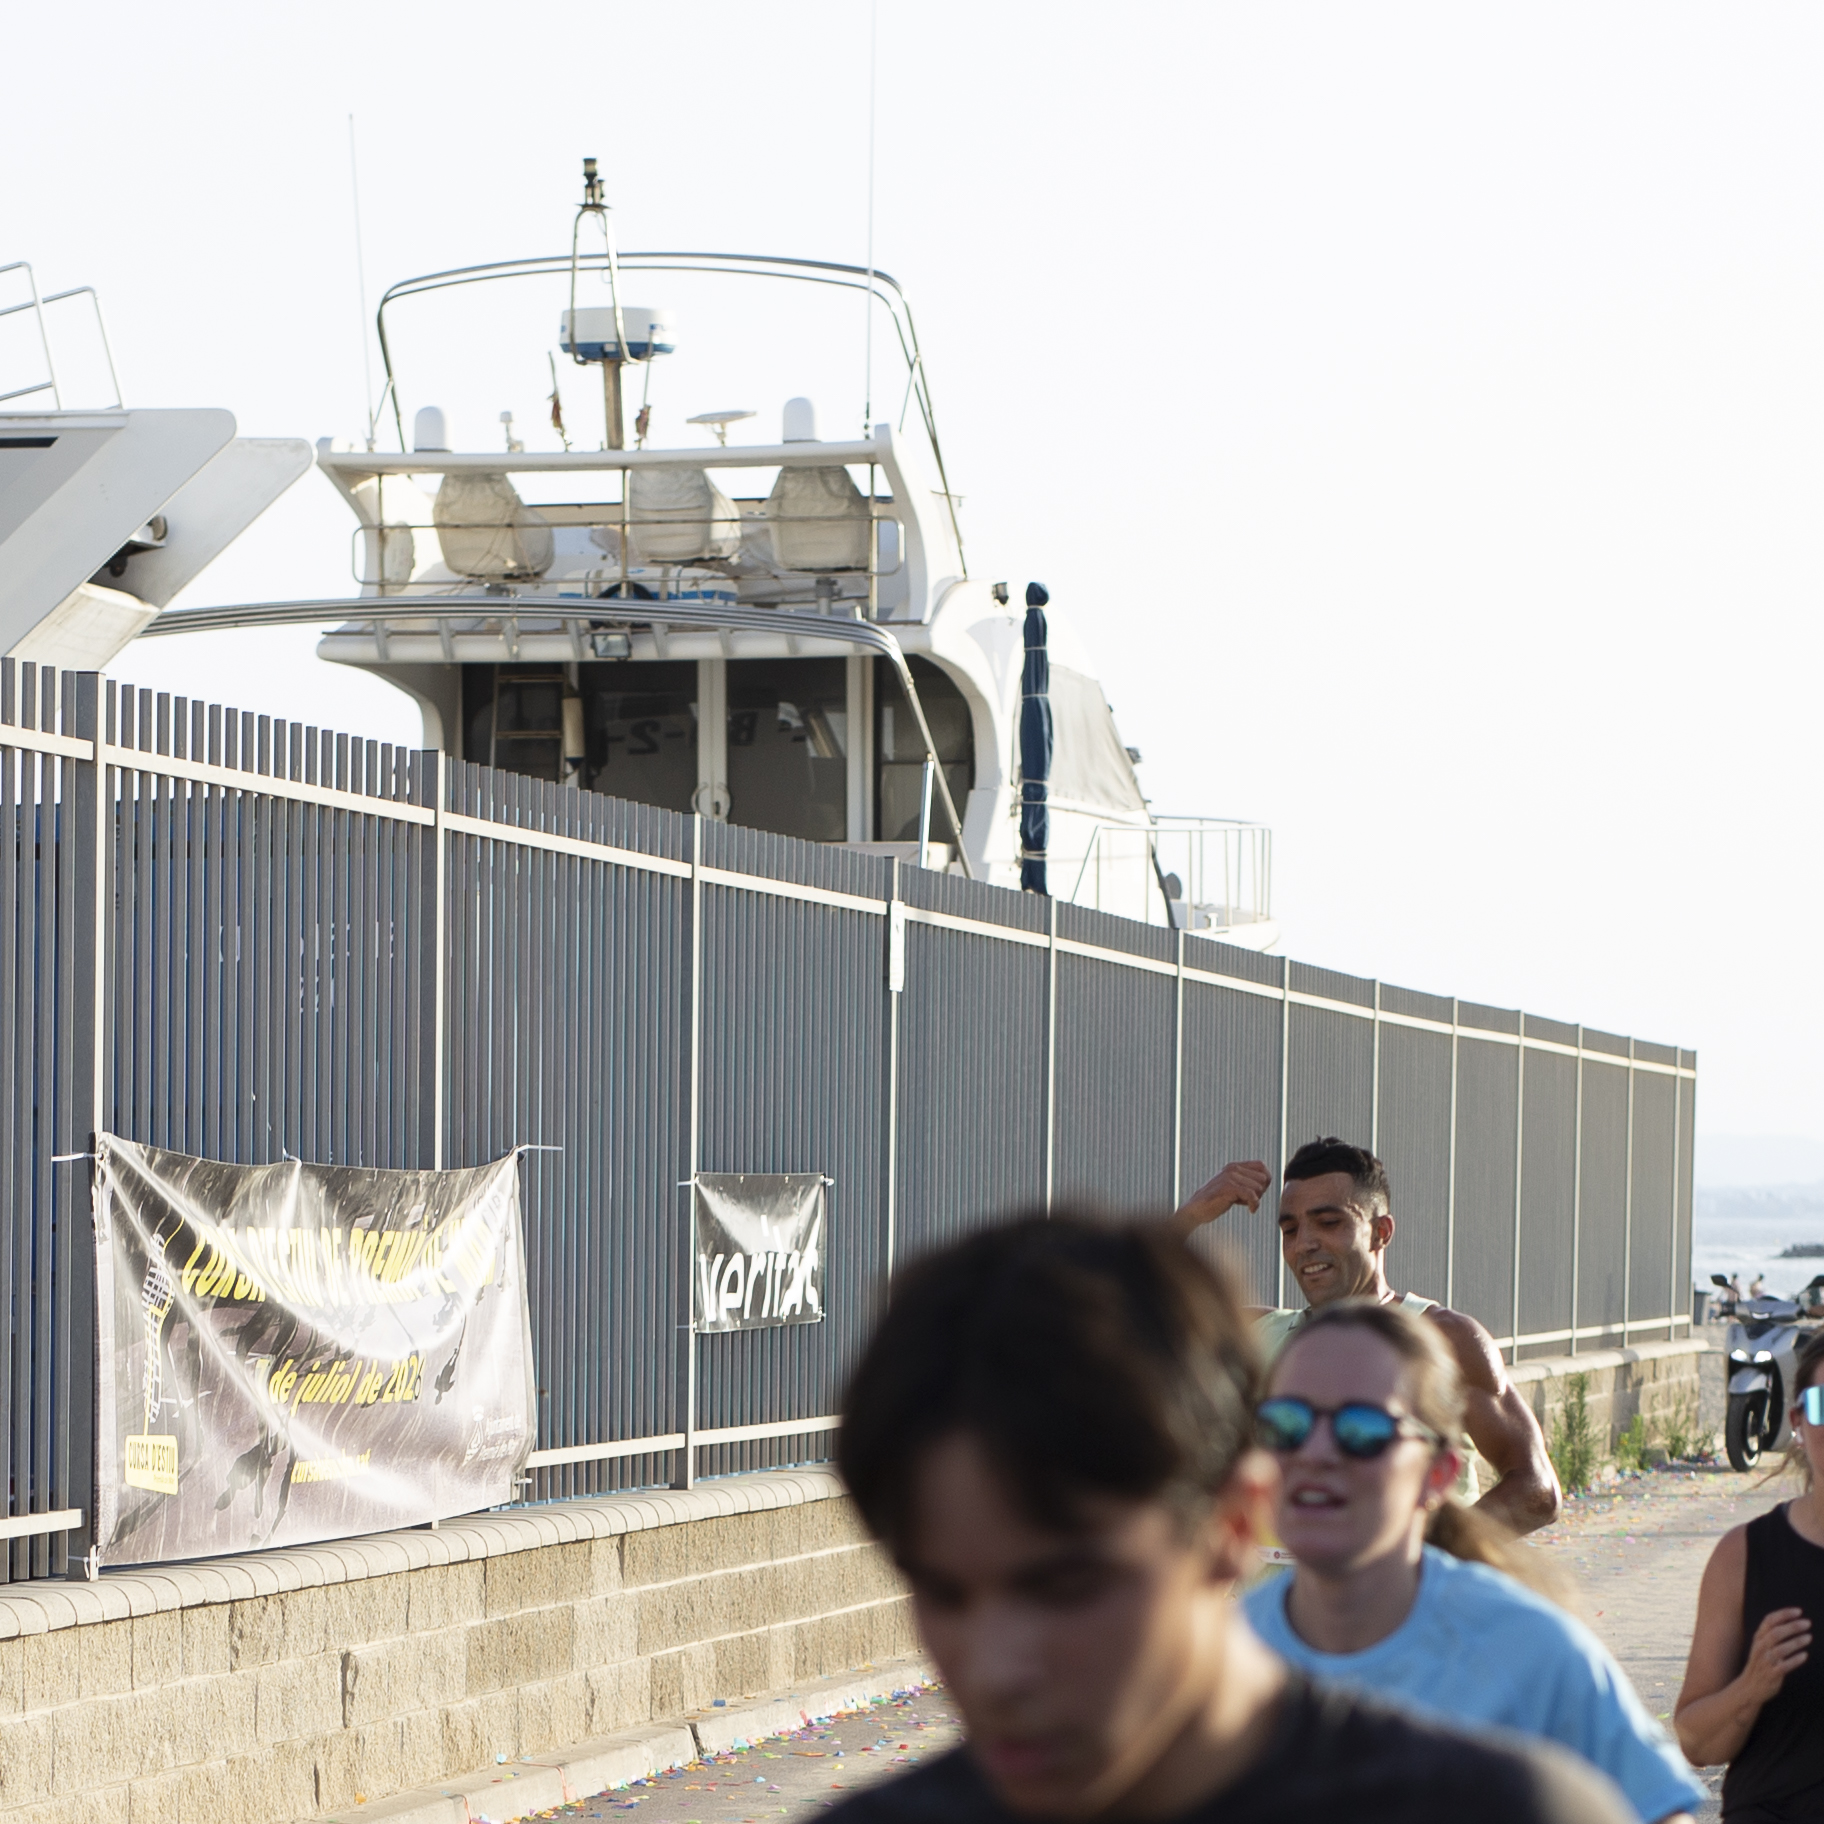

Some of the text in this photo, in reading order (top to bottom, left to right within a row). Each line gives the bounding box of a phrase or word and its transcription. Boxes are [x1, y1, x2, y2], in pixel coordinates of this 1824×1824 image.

[699, 1214, 819, 1323] veritas
[269, 1359, 298, 1405] de
[290, 1360, 363, 1418] juliol
[354, 1359, 384, 1405] de
[128, 1441, 149, 1470] CURSA
